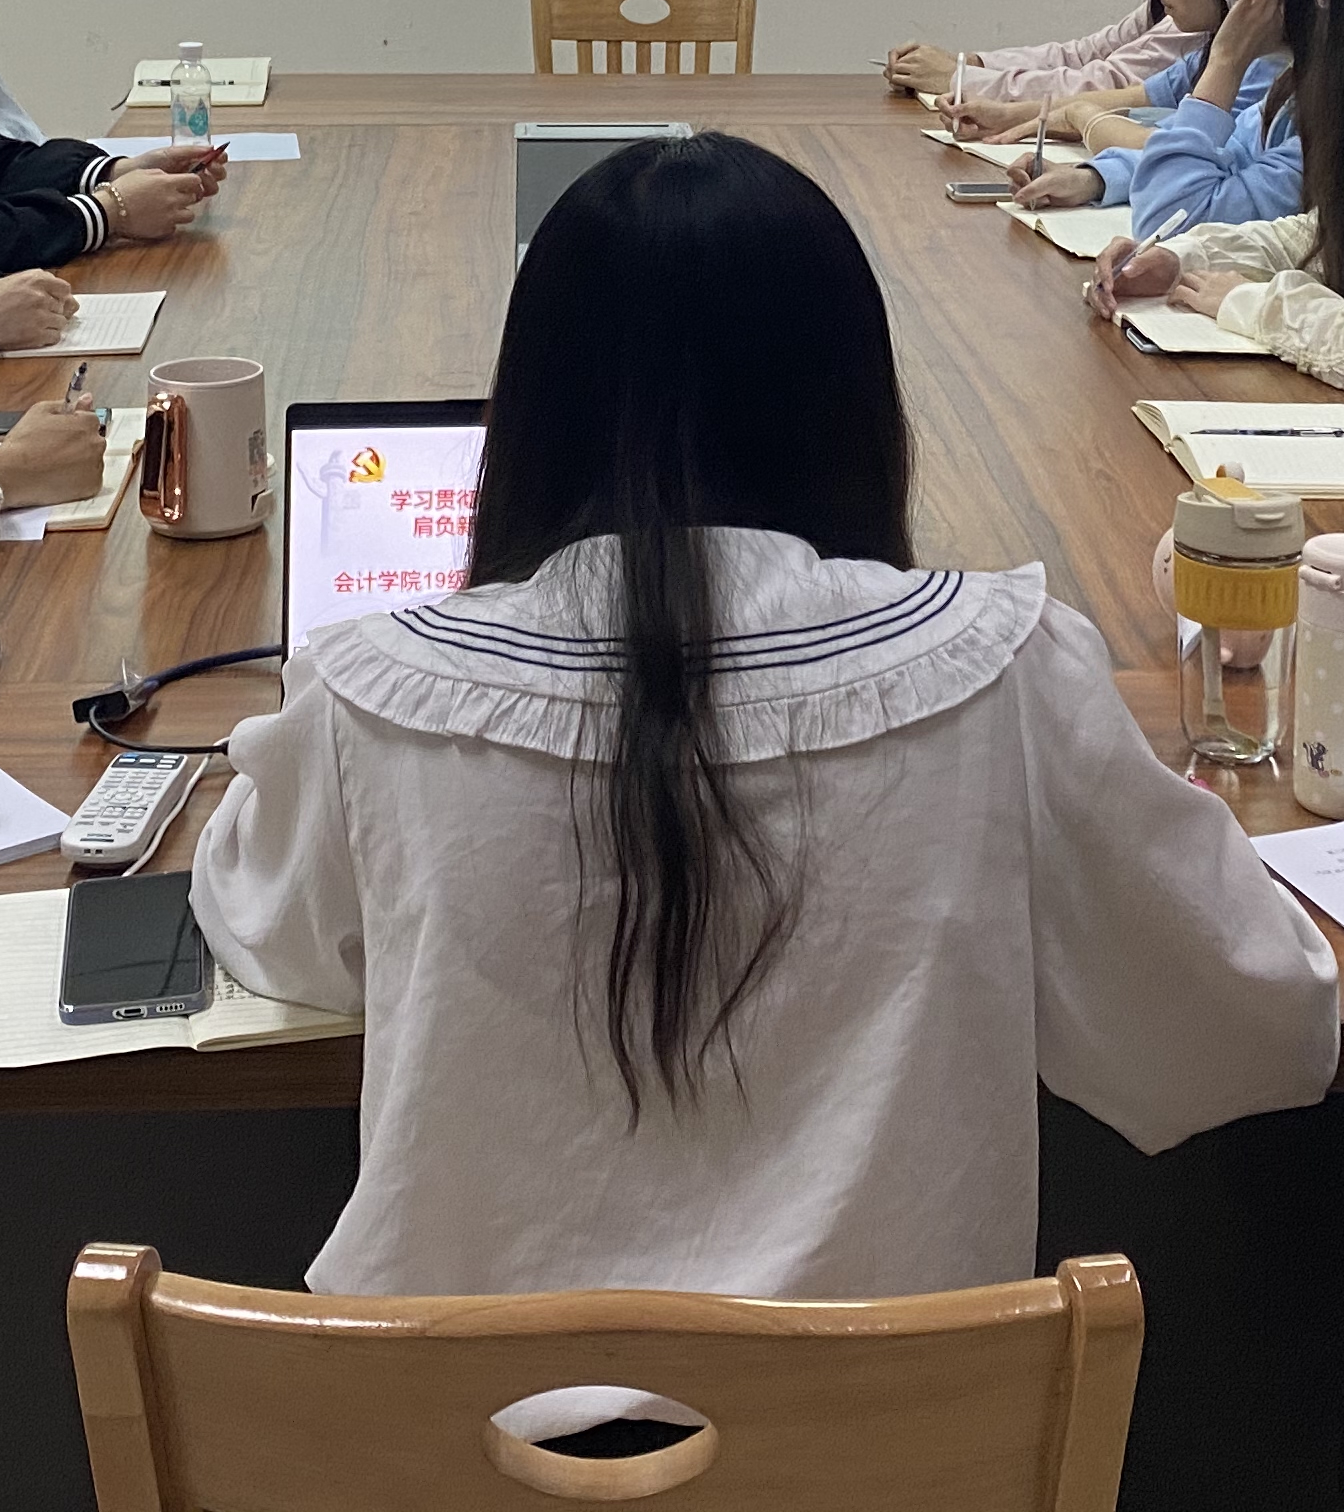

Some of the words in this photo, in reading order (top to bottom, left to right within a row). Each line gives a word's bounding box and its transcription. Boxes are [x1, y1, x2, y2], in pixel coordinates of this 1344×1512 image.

[334, 570, 468, 593] 会计学院19级
